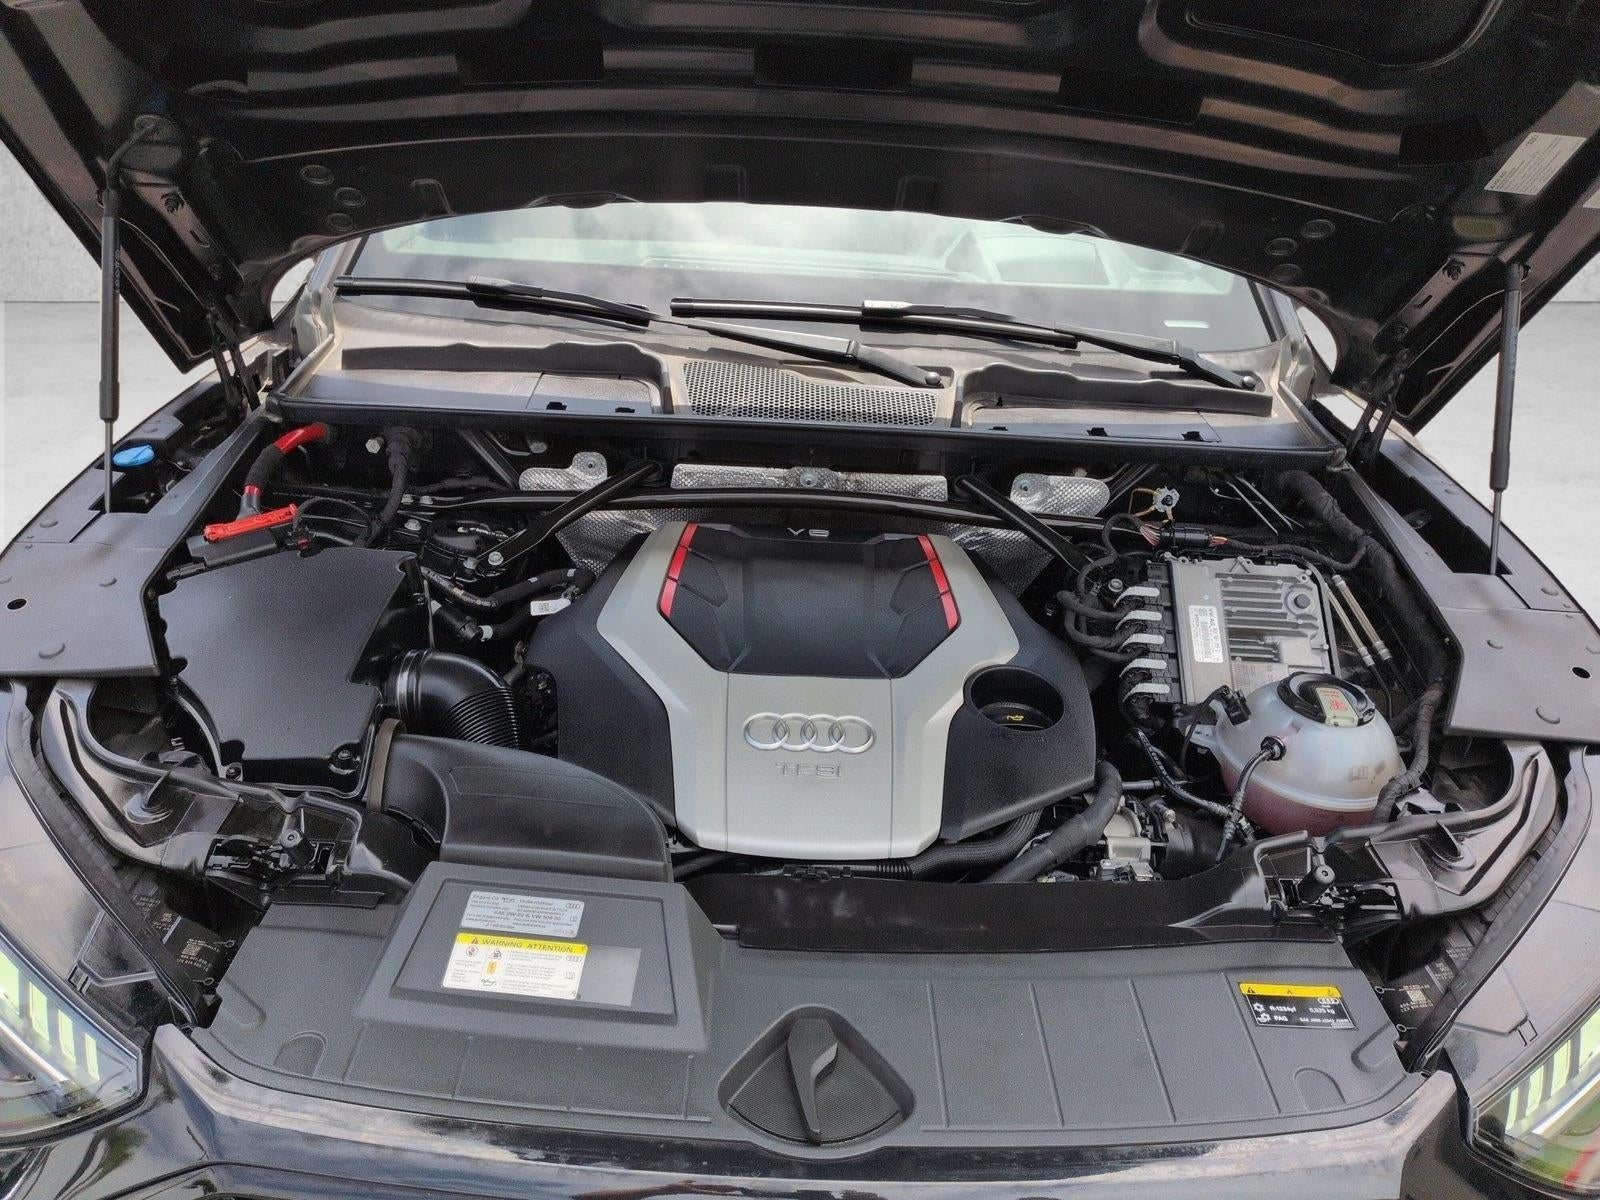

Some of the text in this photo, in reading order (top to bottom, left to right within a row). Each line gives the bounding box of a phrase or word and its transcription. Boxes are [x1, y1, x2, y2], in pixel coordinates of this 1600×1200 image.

[787, 527, 830, 538] V6
[775, 762, 842, 778] TFSI
[482, 939, 574, 953] WARNING ATTENTION
